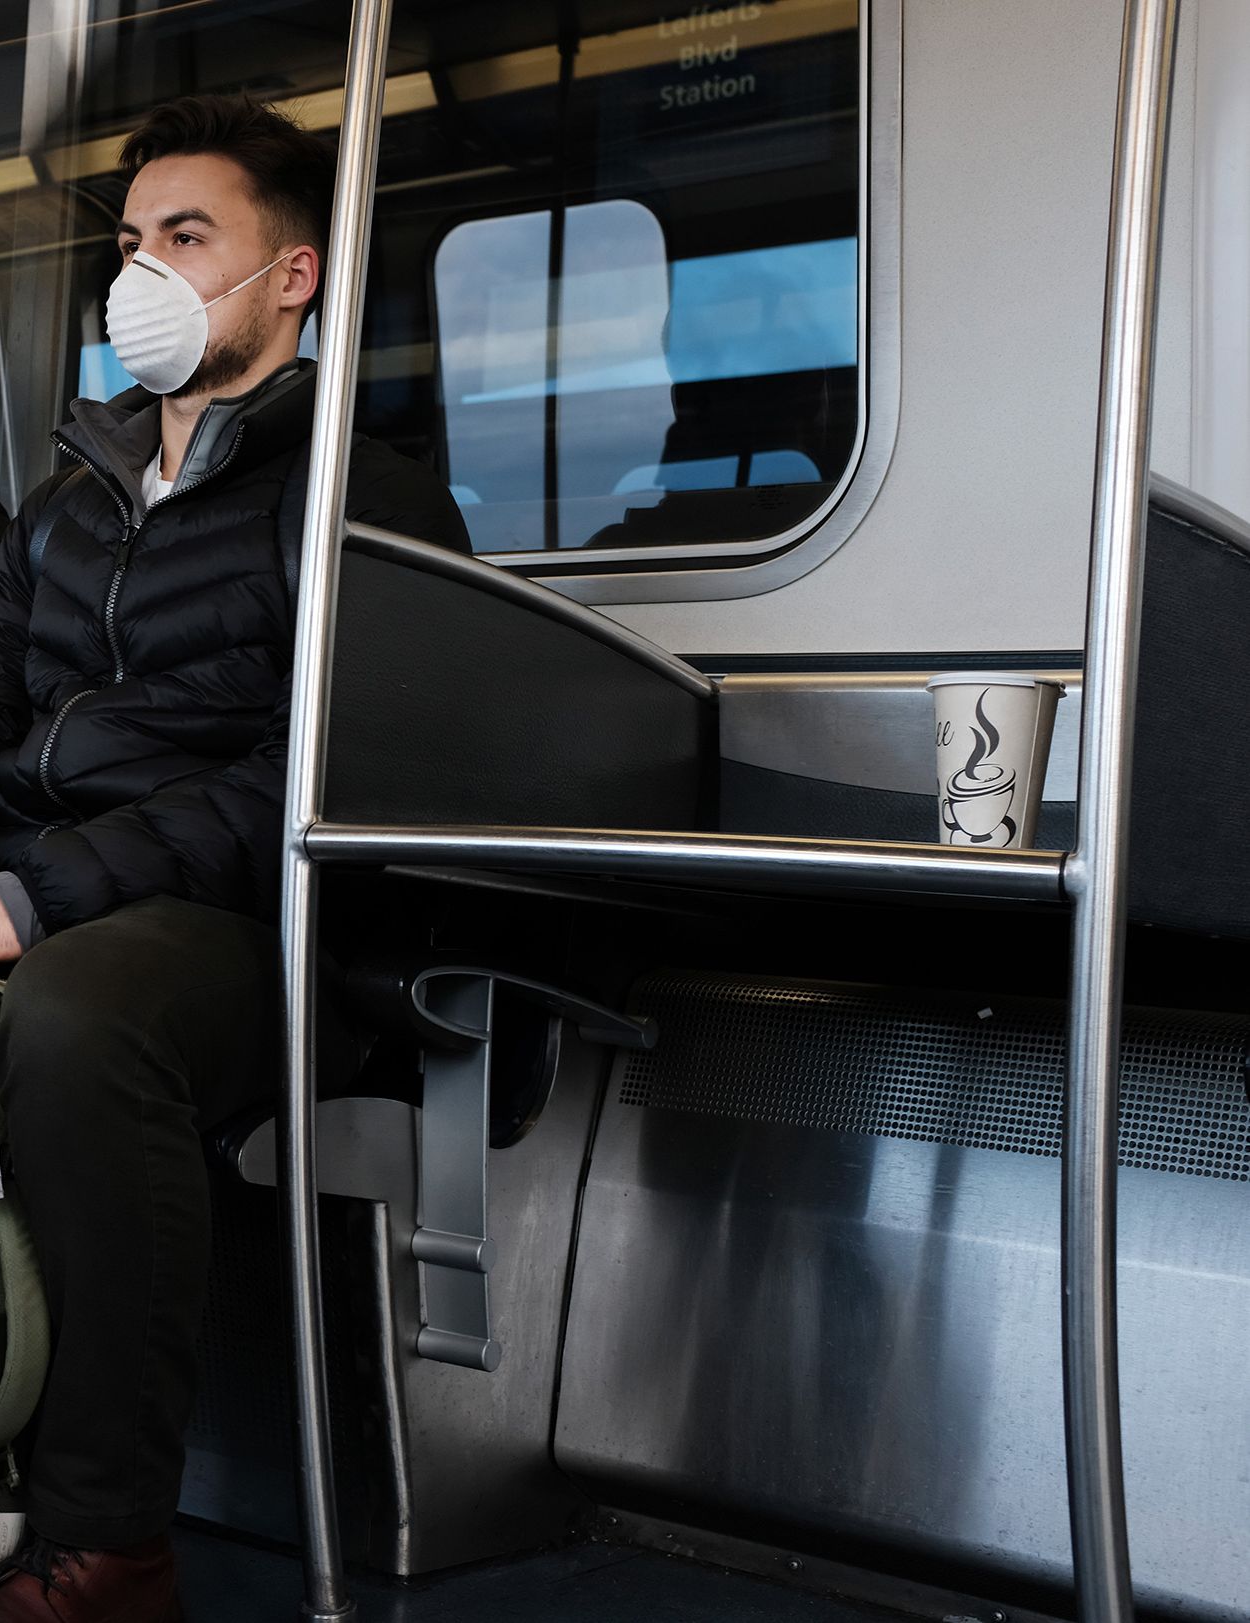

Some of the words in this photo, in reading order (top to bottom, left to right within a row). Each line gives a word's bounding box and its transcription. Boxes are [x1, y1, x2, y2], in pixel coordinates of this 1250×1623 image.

[658, 1, 762, 39] Lefferts
[679, 34, 738, 71] Blvd
[660, 73, 756, 112] Station
